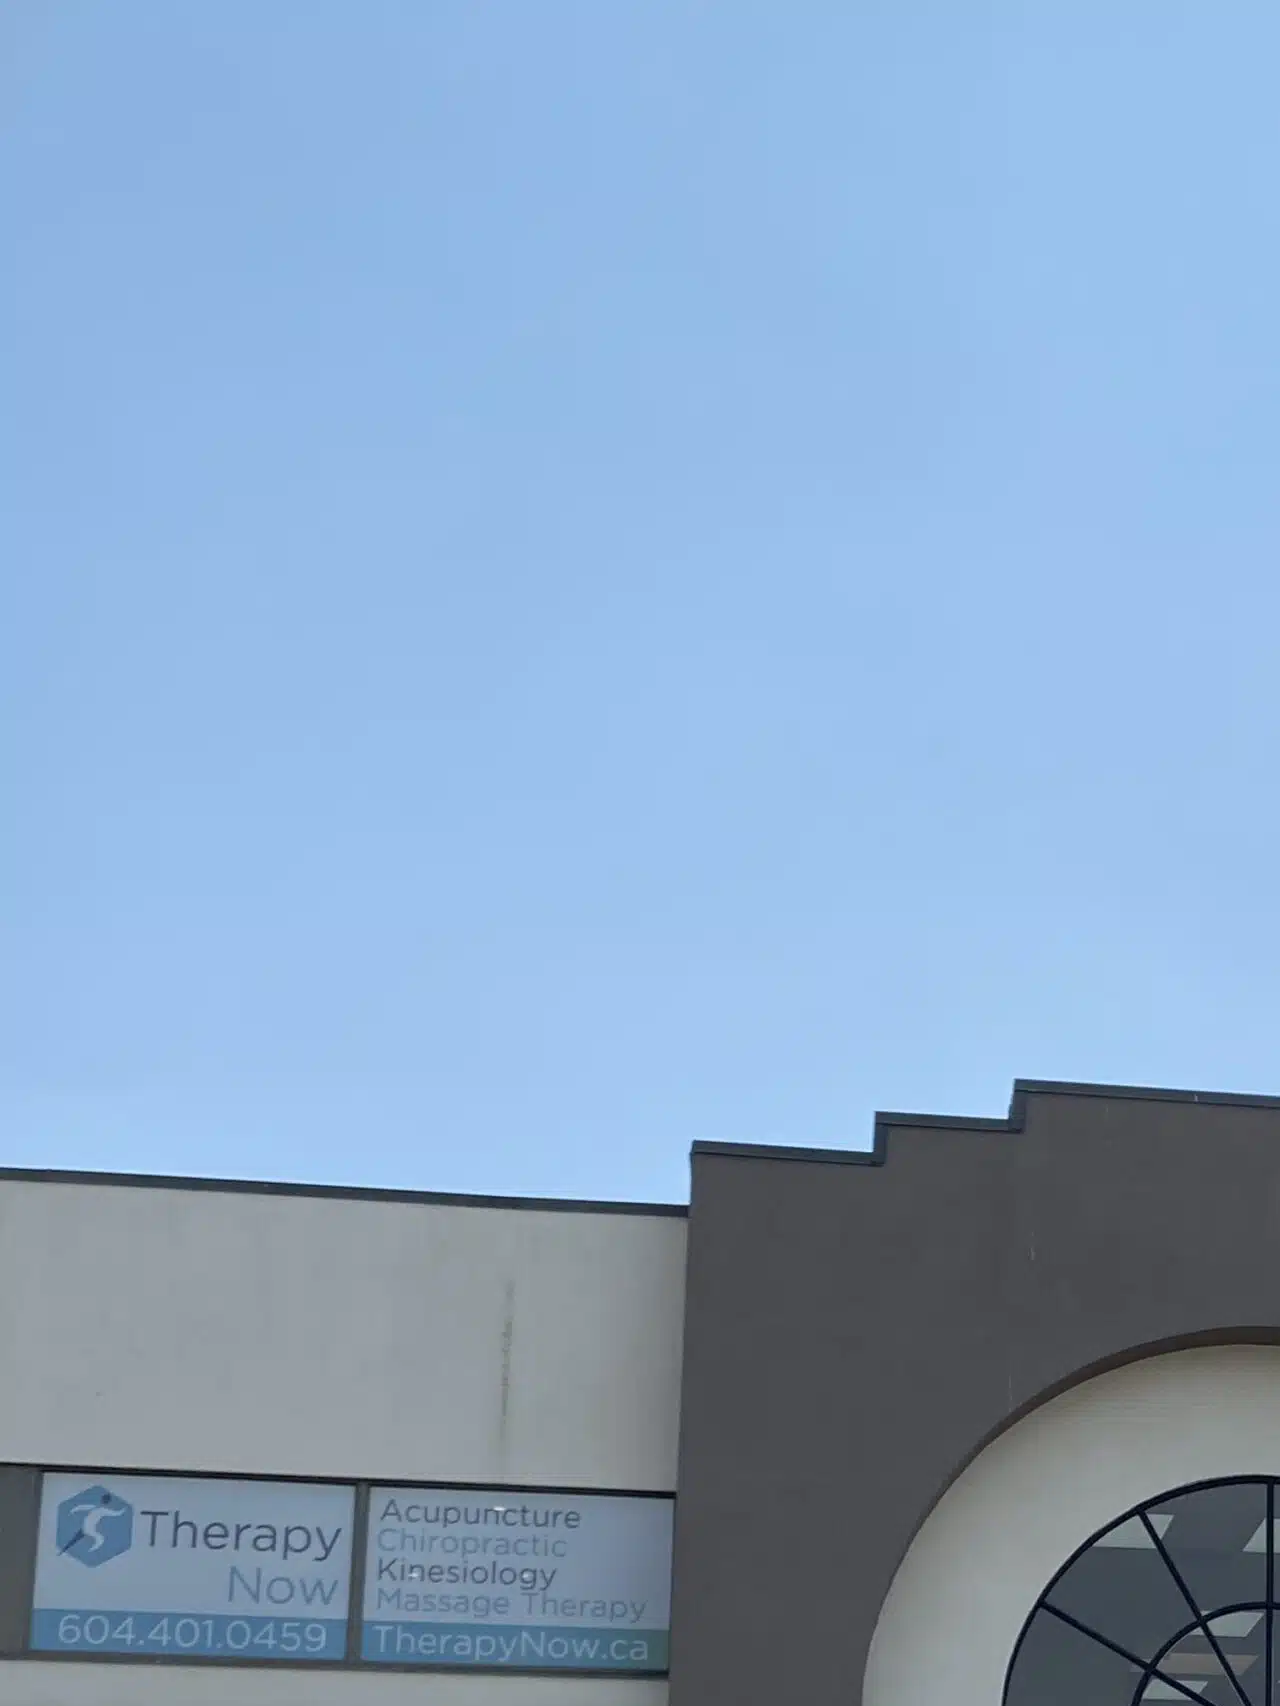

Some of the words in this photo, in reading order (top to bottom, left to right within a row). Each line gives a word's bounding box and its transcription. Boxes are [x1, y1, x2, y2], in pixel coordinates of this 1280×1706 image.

[379, 1498, 581, 1529] Acupuncture
[140, 1510, 342, 1562] Therapy
[376, 1528, 568, 1558] Chiropractic
[228, 1565, 339, 1606] Now
[377, 1558, 557, 1591] Kinesiology
[376, 1587, 511, 1618] Massage
[520, 1592, 647, 1623] Therapy
[57, 1614, 327, 1652] 604.401.0459
[372, 1625, 649, 1662] TherapyNow.ca
